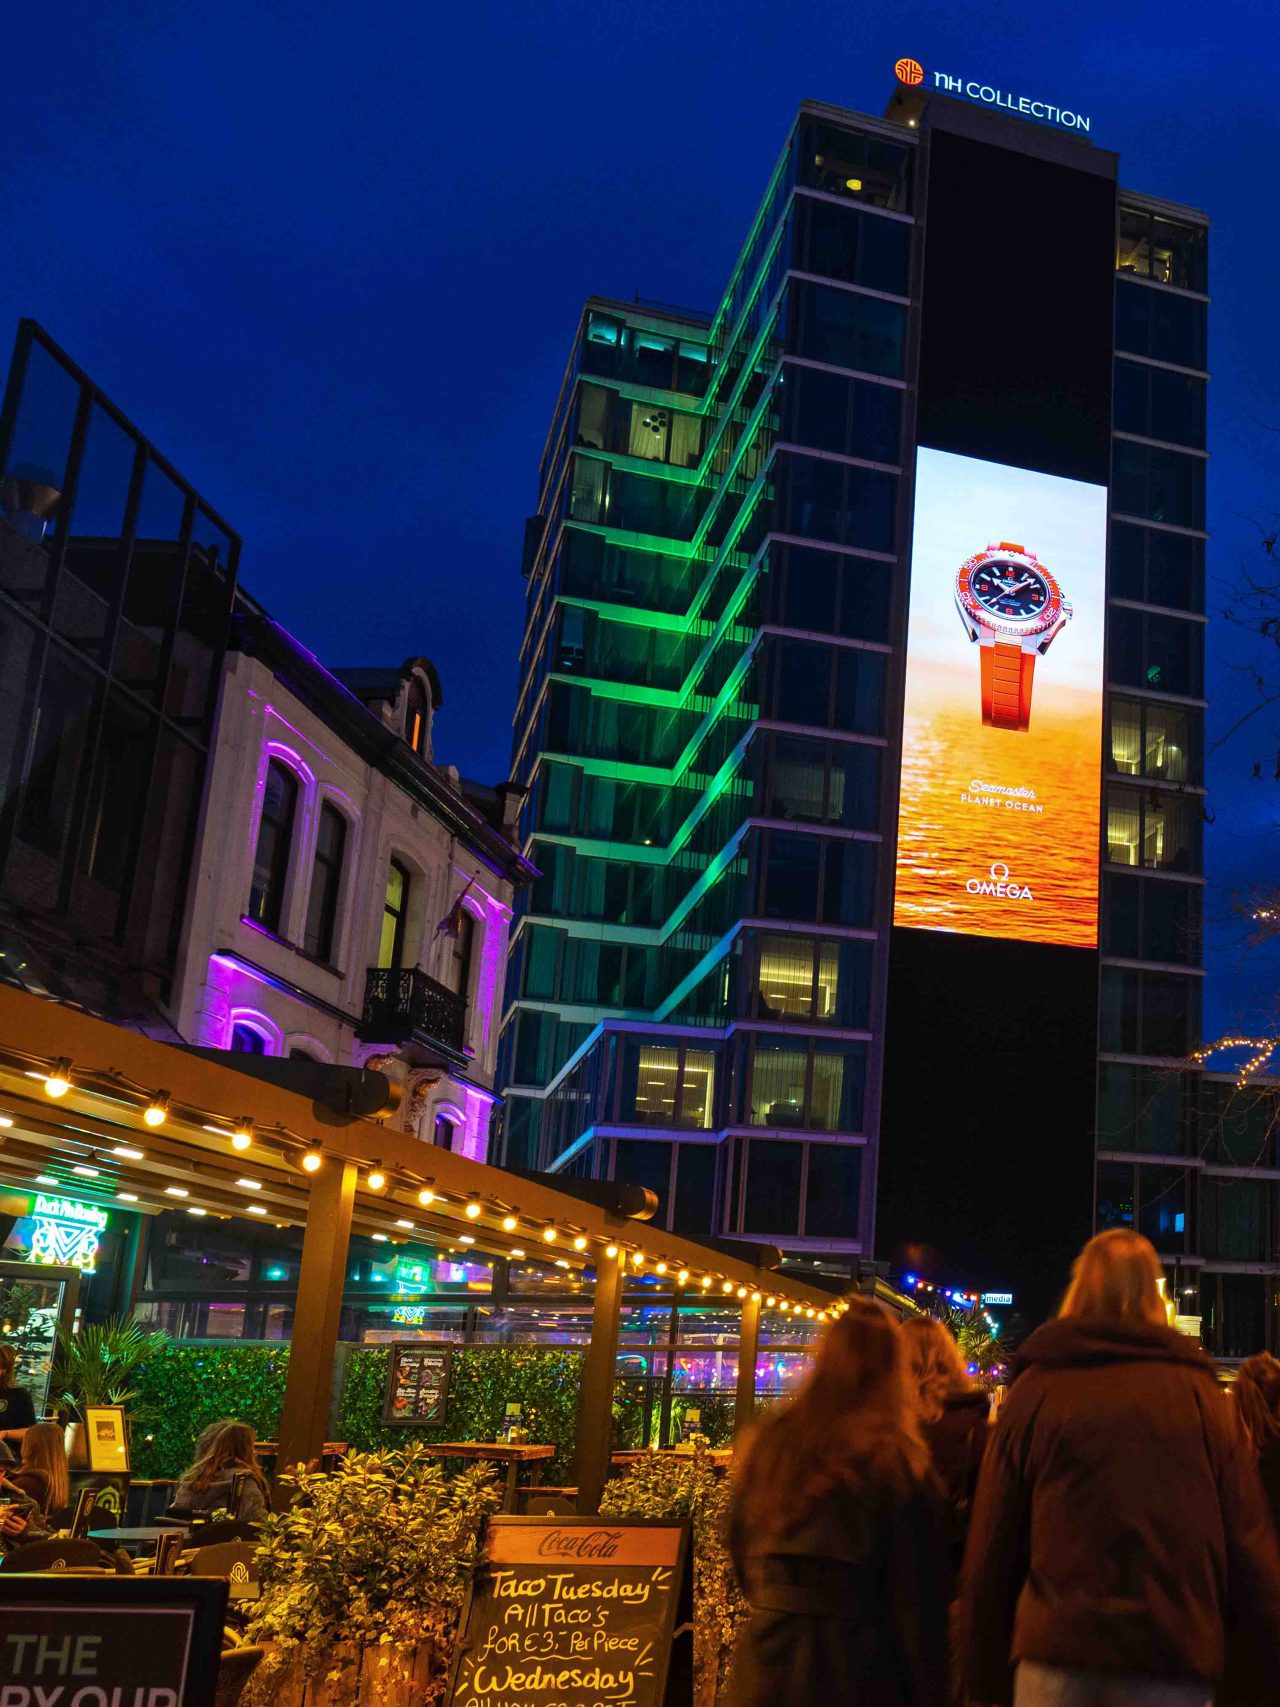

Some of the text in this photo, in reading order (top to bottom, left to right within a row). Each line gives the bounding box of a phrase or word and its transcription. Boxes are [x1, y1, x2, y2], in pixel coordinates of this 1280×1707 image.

[966, 82, 1090, 132] COLLECTION
[968, 779, 1036, 799] Seamaster
[961, 794, 1043, 813] PLANET OCEAN
[965, 878, 1033, 901] OMEGA
[986, 1295, 1011, 1303] media
[538, 1531, 625, 1559] Coca-Cola
[490, 1571, 650, 1604] Taco Tuesday
[504, 1603, 610, 1628] All Taco's
[594, 1630, 639, 1651] Piece
[7, 1634, 102, 1675] THE
[474, 1665, 635, 1699] Wednesday
